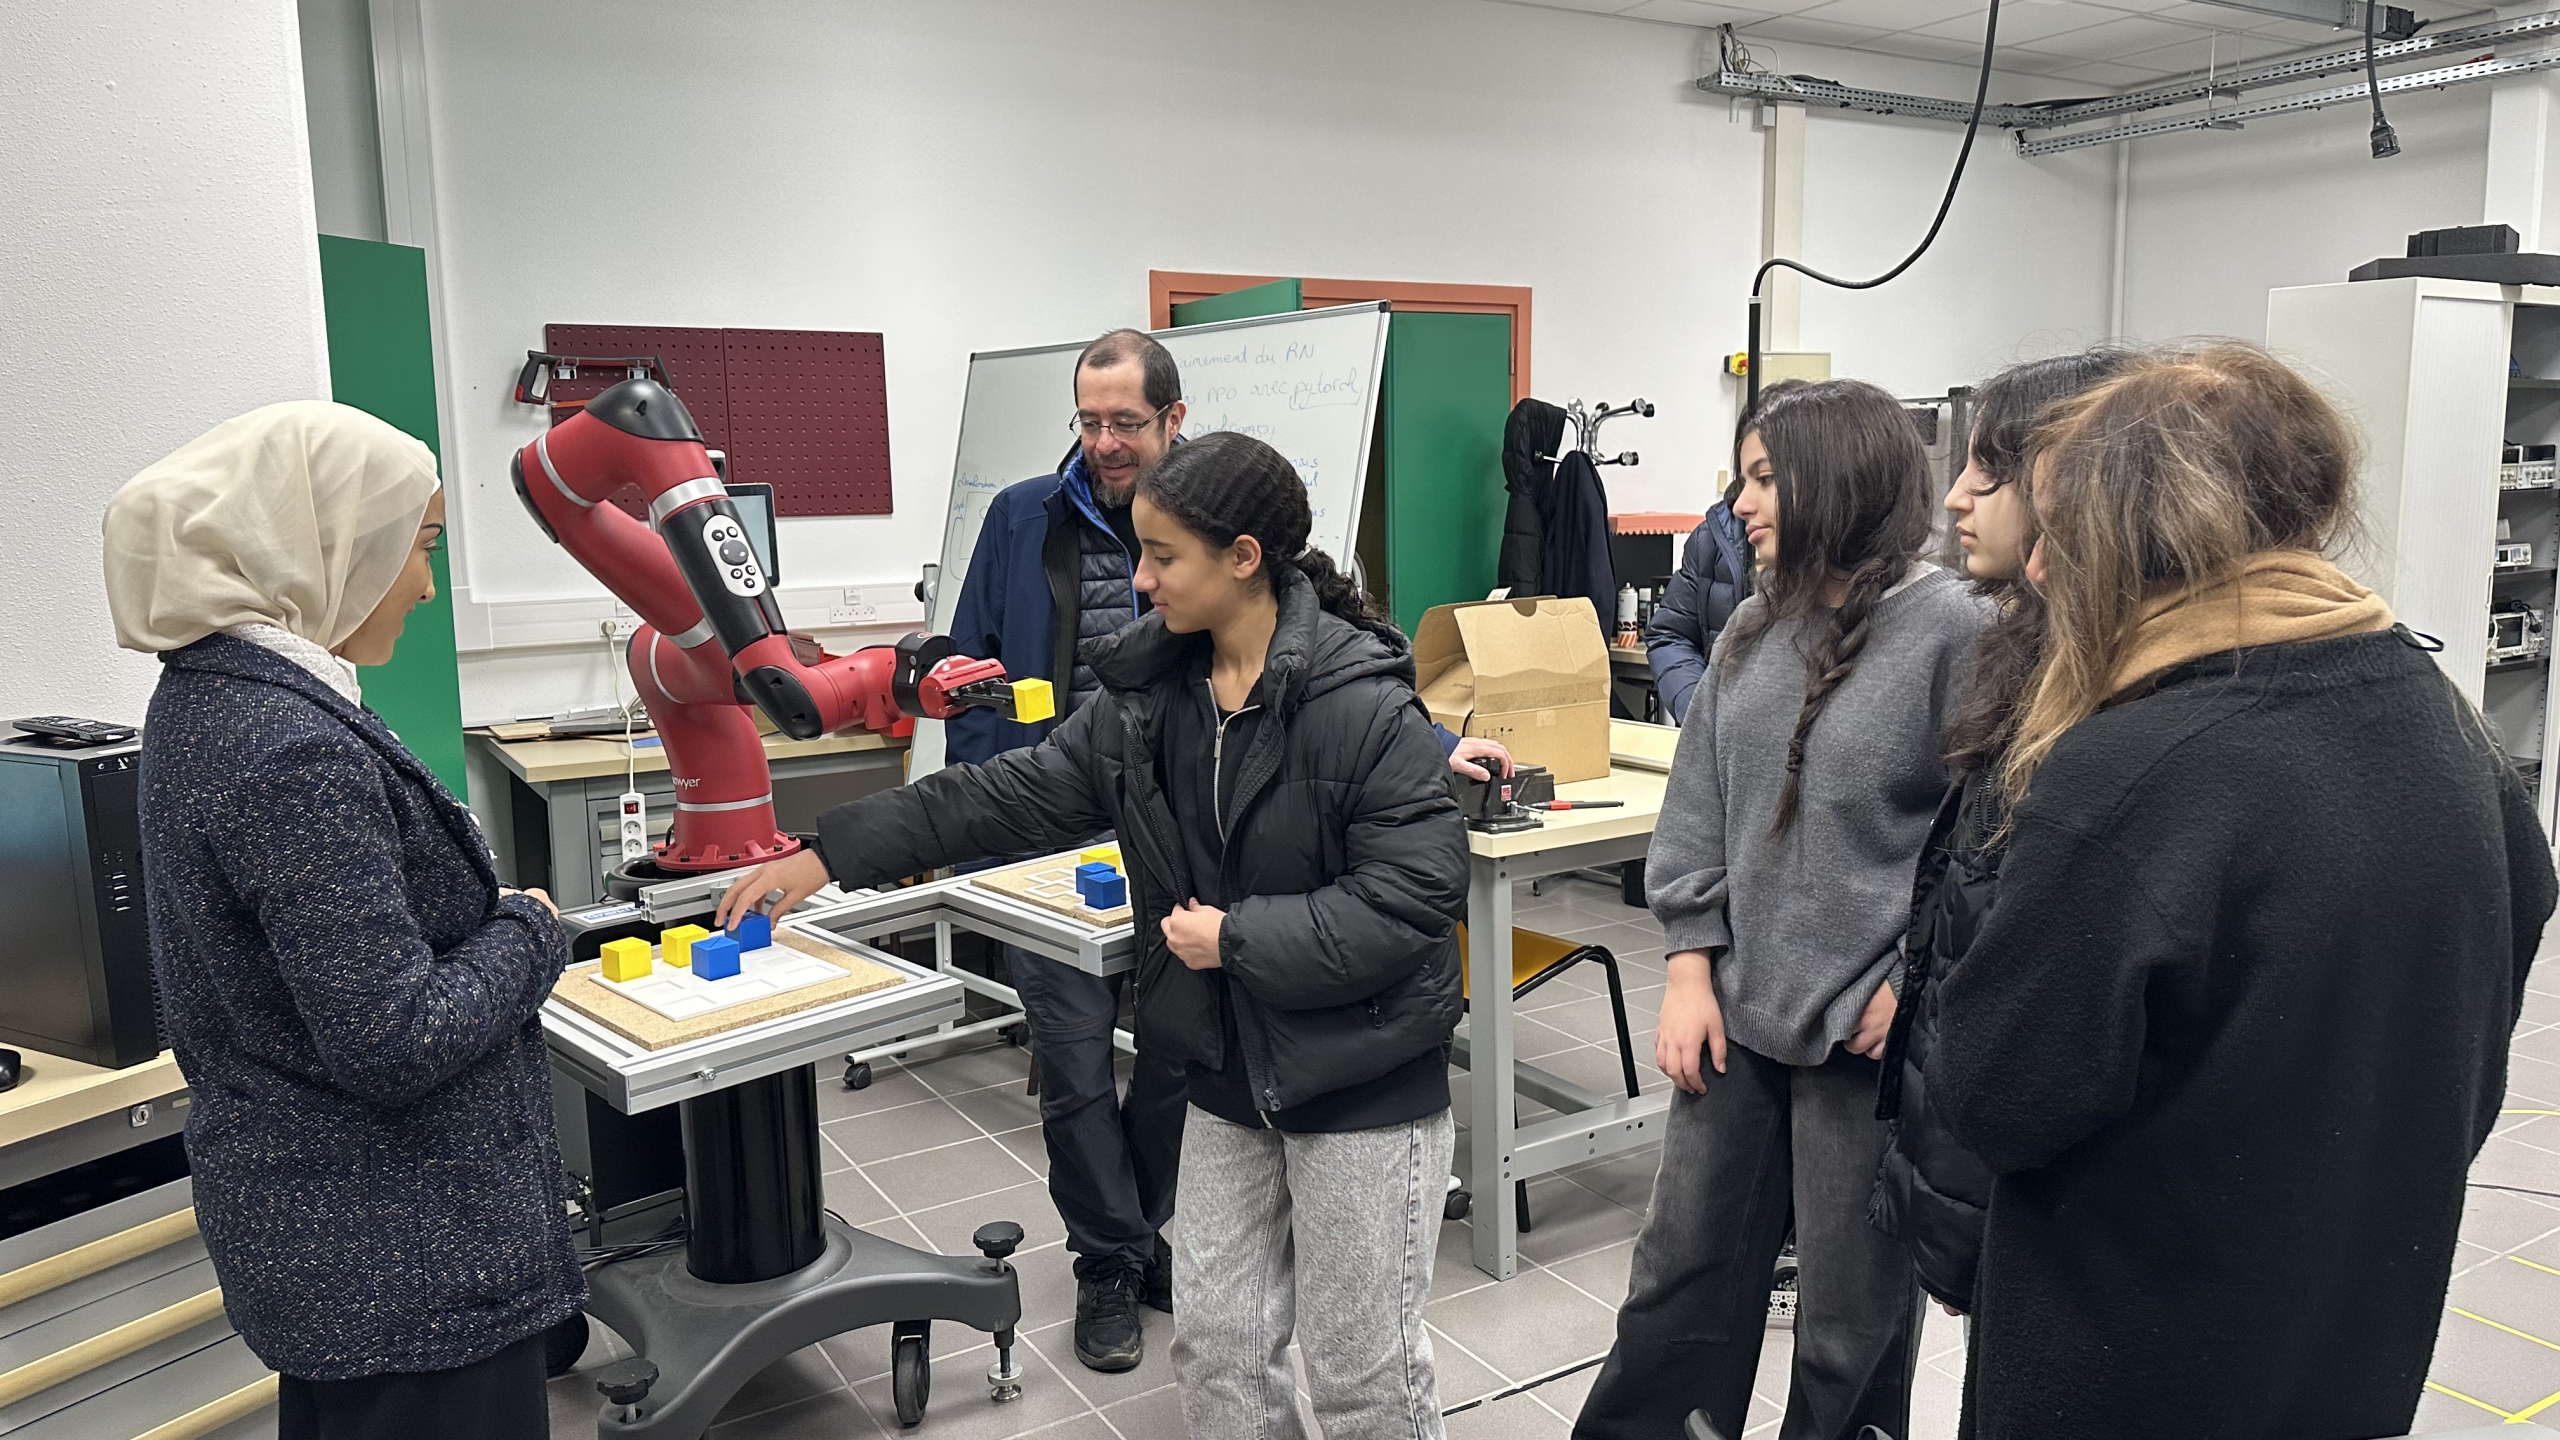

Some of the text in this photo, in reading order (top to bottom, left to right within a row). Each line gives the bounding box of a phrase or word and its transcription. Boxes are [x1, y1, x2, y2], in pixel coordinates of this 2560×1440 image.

[1254, 345, 1276, 365] du
[1285, 341, 1315, 362] RN
[1207, 386, 1237, 403] PPO
[672, 775, 700, 791] awyer
